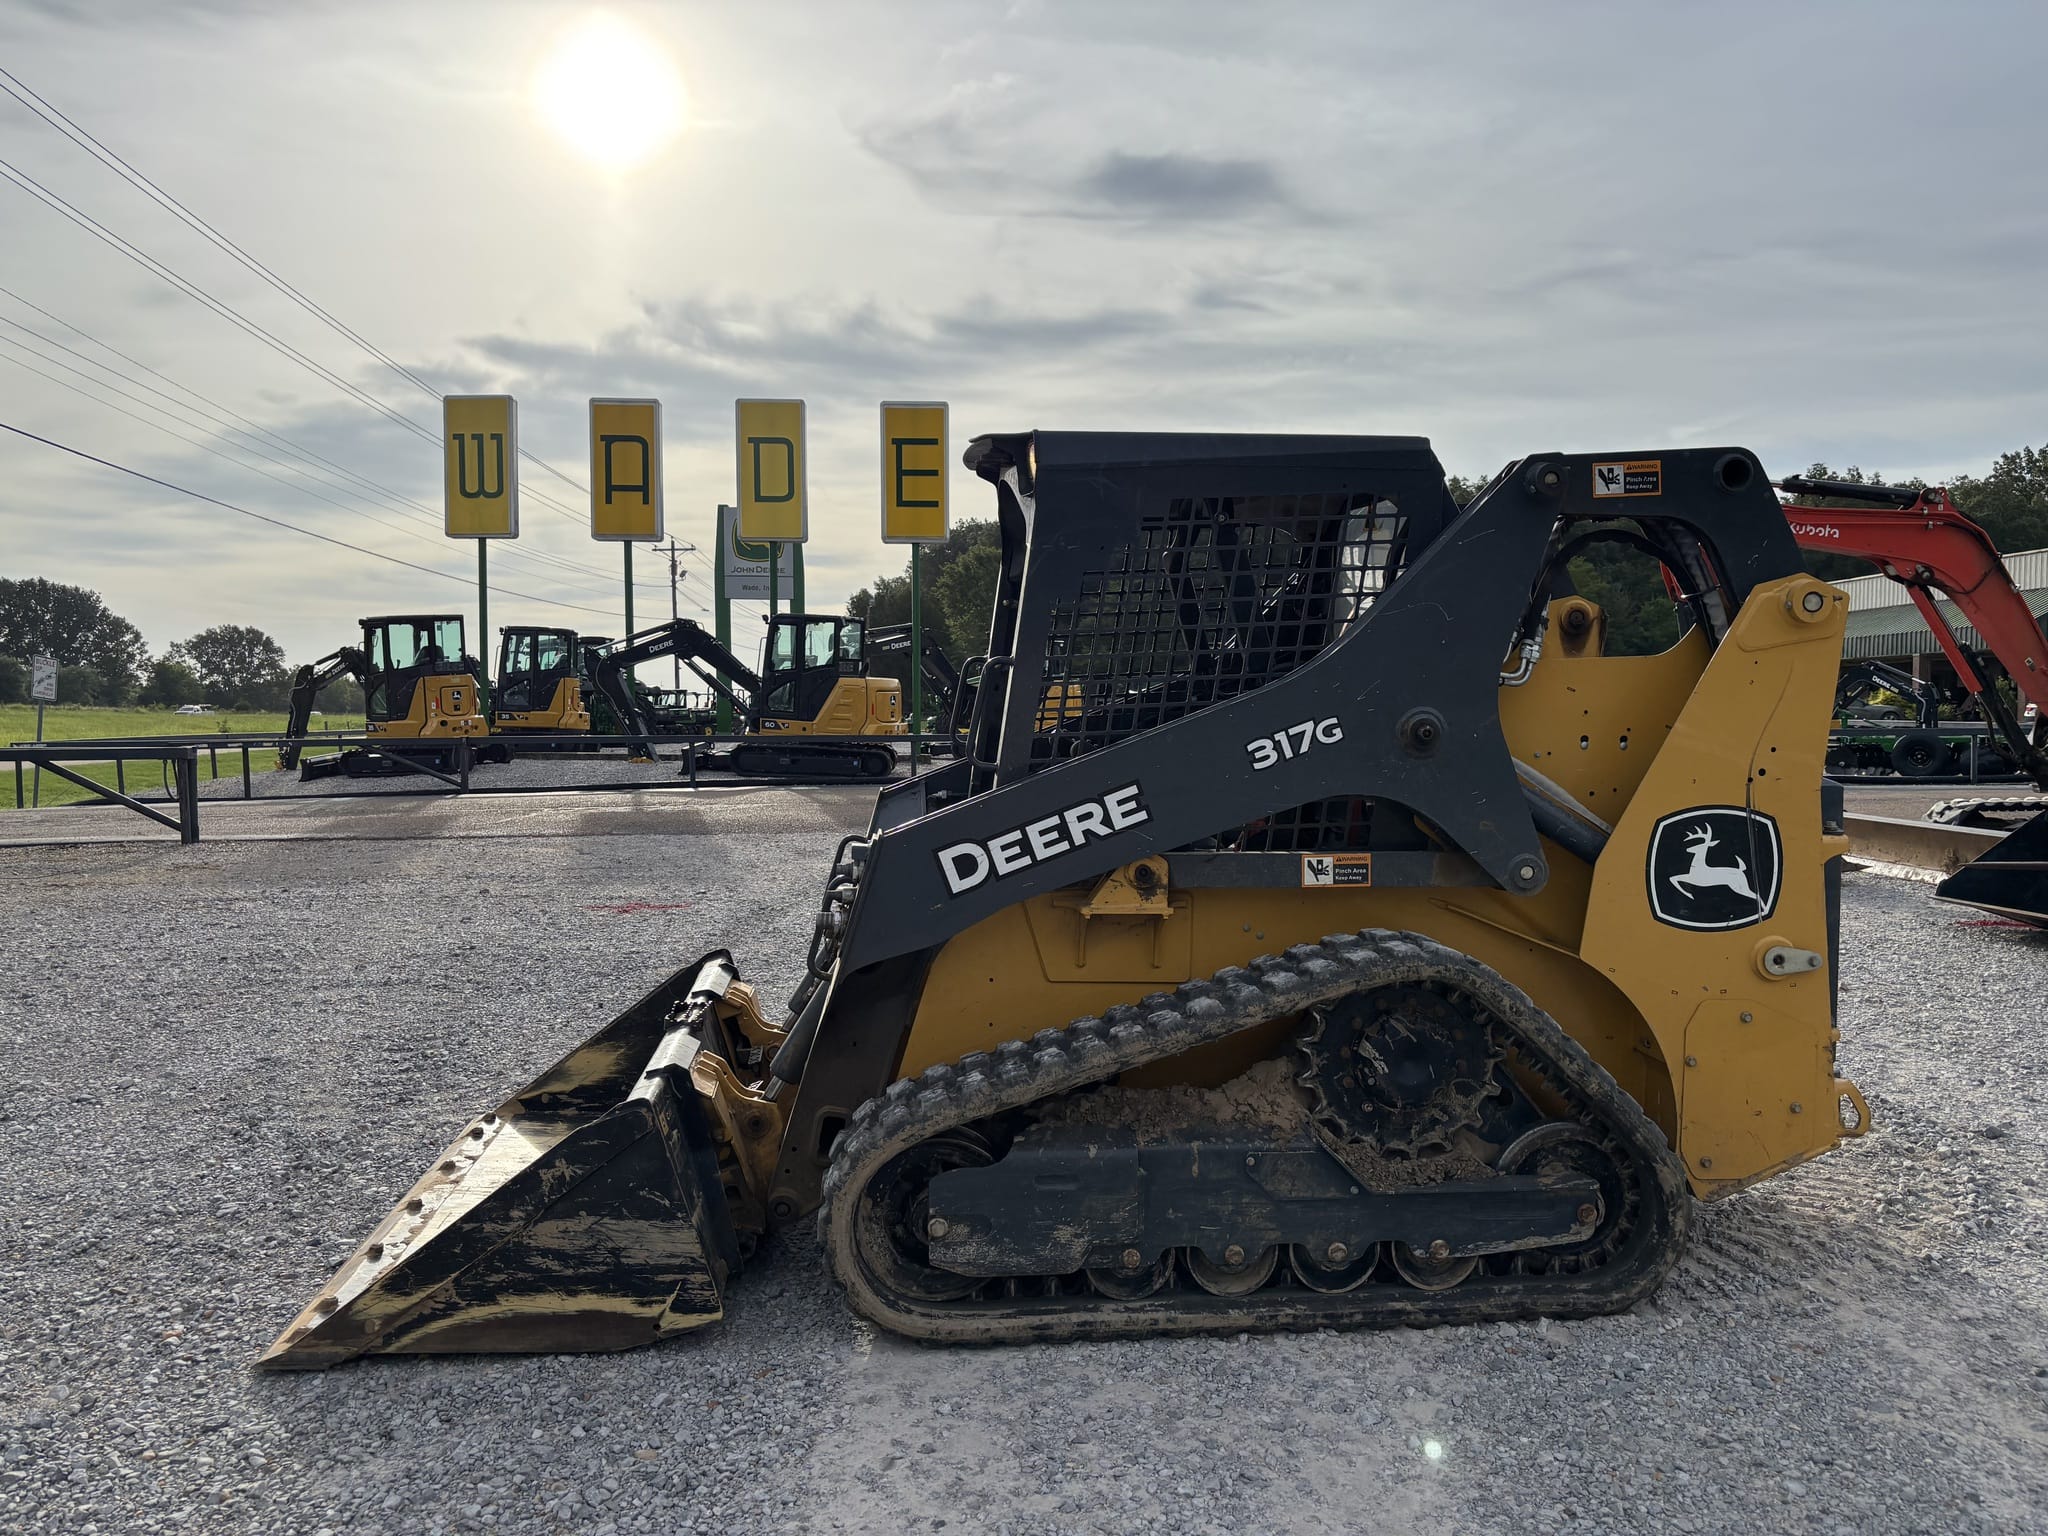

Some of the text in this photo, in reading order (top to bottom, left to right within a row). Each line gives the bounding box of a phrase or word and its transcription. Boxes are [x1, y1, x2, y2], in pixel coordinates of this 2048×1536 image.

[648, 639, 674, 654] DEERE
[890, 640, 912, 650] DEERE
[1872, 675, 1891, 688] DEERE
[1245, 716, 1344, 771] 317G
[937, 784, 1149, 895] DEERE
